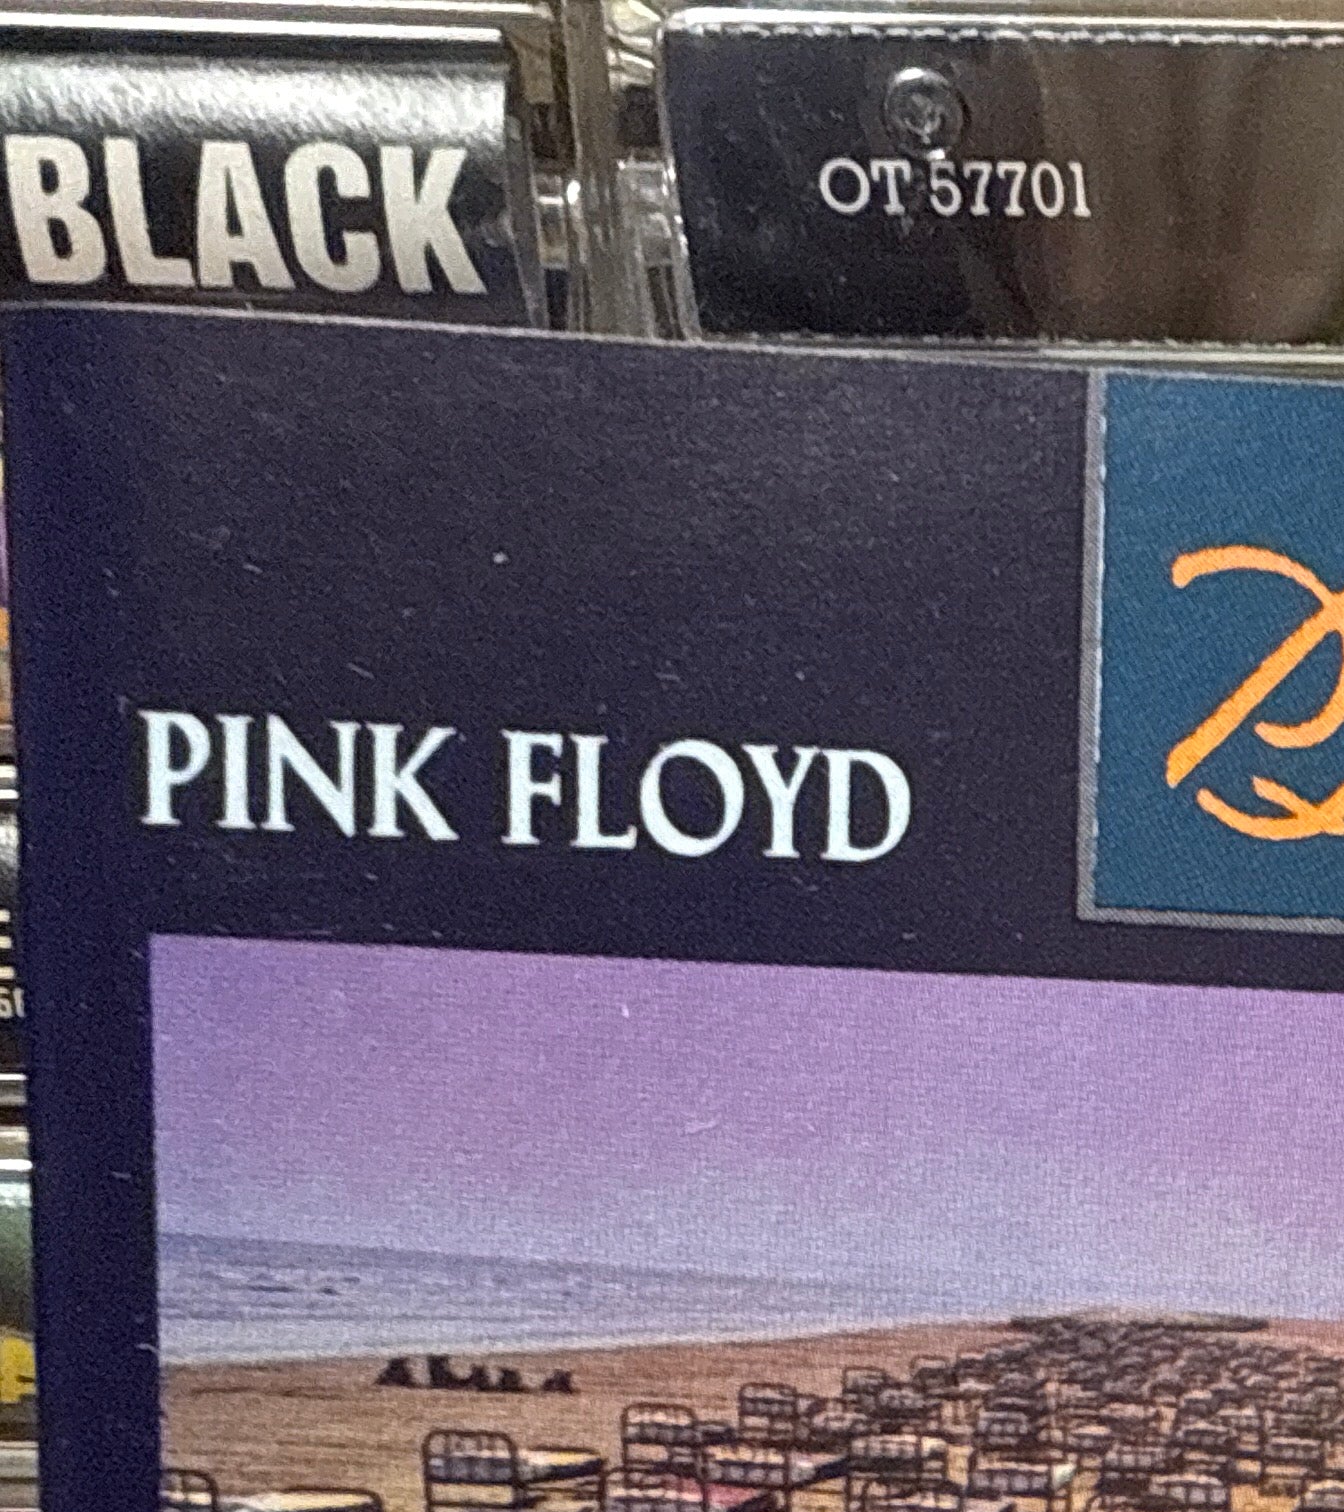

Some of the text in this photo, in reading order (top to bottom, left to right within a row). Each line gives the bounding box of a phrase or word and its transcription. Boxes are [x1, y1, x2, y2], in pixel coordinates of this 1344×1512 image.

[2, 130, 490, 298] BLACK
[818, 157, 1092, 218] OT 57701
[140, 710, 911, 862] PINK FLOYD
